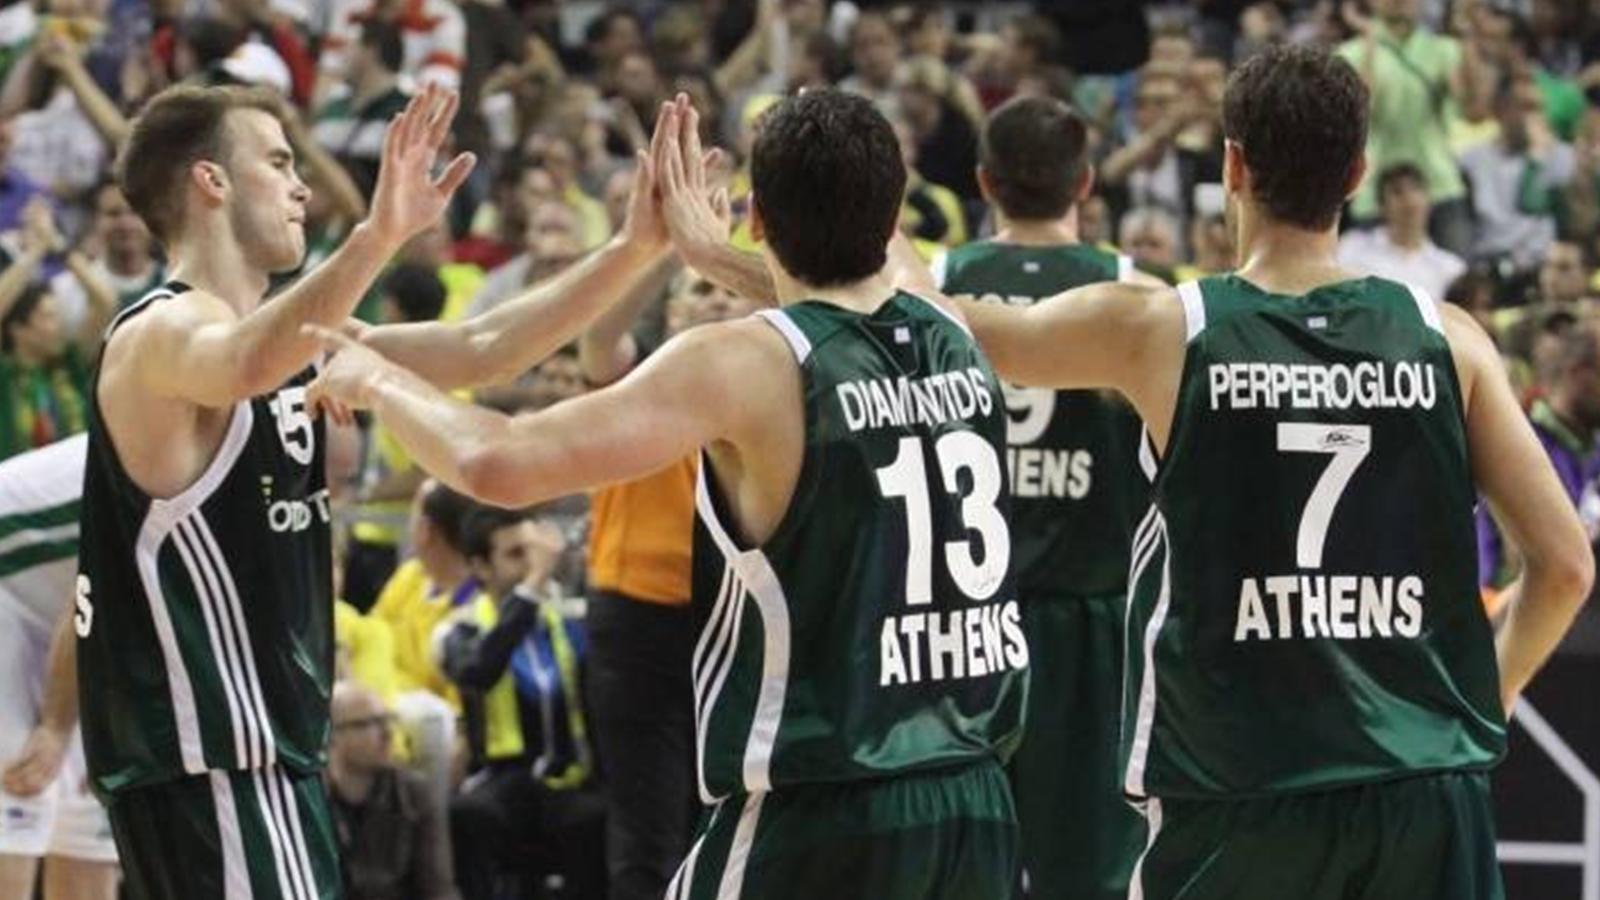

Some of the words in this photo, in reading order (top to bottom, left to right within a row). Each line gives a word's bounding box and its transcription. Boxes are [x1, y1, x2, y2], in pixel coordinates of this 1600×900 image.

[1209, 361, 1436, 410] PERPEROGLOU
[876, 430, 1010, 604] 13
[1277, 422, 1371, 568] 7
[880, 601, 1029, 686] ATHENS
[1234, 576, 1424, 641] ATHENS
